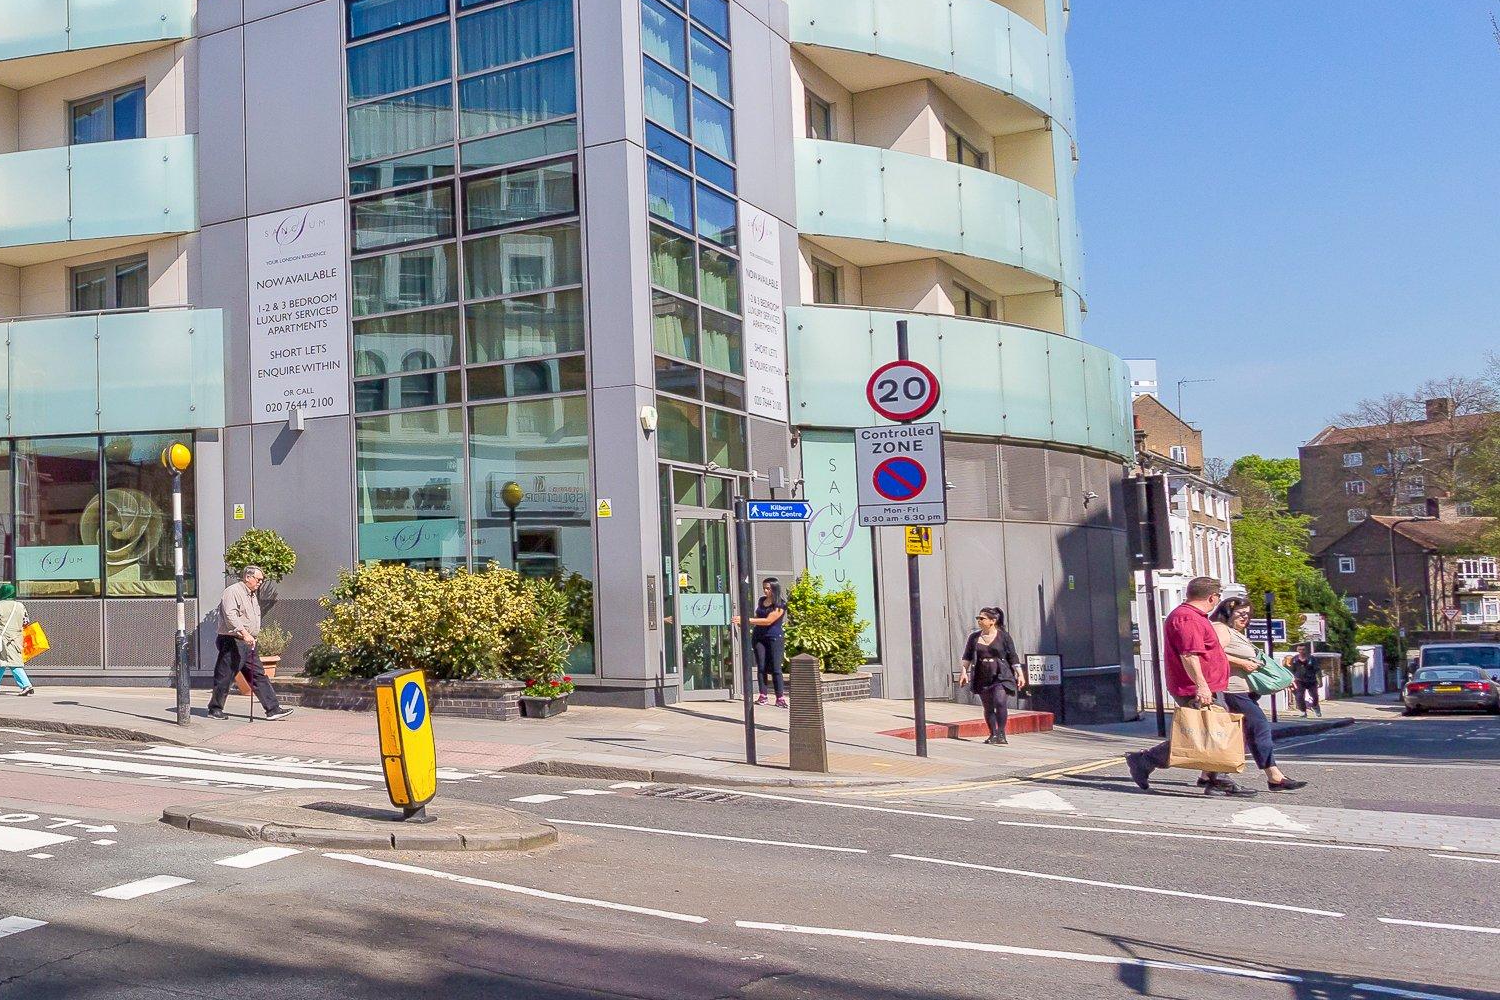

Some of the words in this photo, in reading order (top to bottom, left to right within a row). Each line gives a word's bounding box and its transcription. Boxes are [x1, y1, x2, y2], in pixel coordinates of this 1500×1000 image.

[280, 255, 301, 264] LONDON
[302, 251, 326, 259] RESIDENCE
[256, 277, 285, 290] NOW
[285, 268, 337, 286] AVAILABLE
[258, 303, 271, 313] 1-2
[273, 302, 279, 311] &
[282, 301, 287, 310] 3
[289, 293, 338, 309] BEDROOM
[256, 312, 293, 326] LUXURY
[295, 305, 339, 320] SERVICED
[267, 319, 328, 335] APARTMENTS
[270, 347, 302, 360] SHORT
[305, 344, 327, 355] LETS
[257, 365, 301, 378] ENQUIRE
[302, 360, 340, 372] WITHIN
[283, 389, 295, 397] OR
[296, 388, 315, 396] CALL
[877, 376, 927, 403] 20
[265, 402, 283, 413] 020
[285, 400, 308, 411] 7644
[310, 396, 334, 408] 2100
[861, 426, 935, 440] Controlled
[871, 439, 924, 454] ZONE
[781, 510, 803, 518] Centre
[828, 458, 847, 583] SANCTU
[863, 515, 884, 523] 8.30
[927, 514, 941, 522] pm
